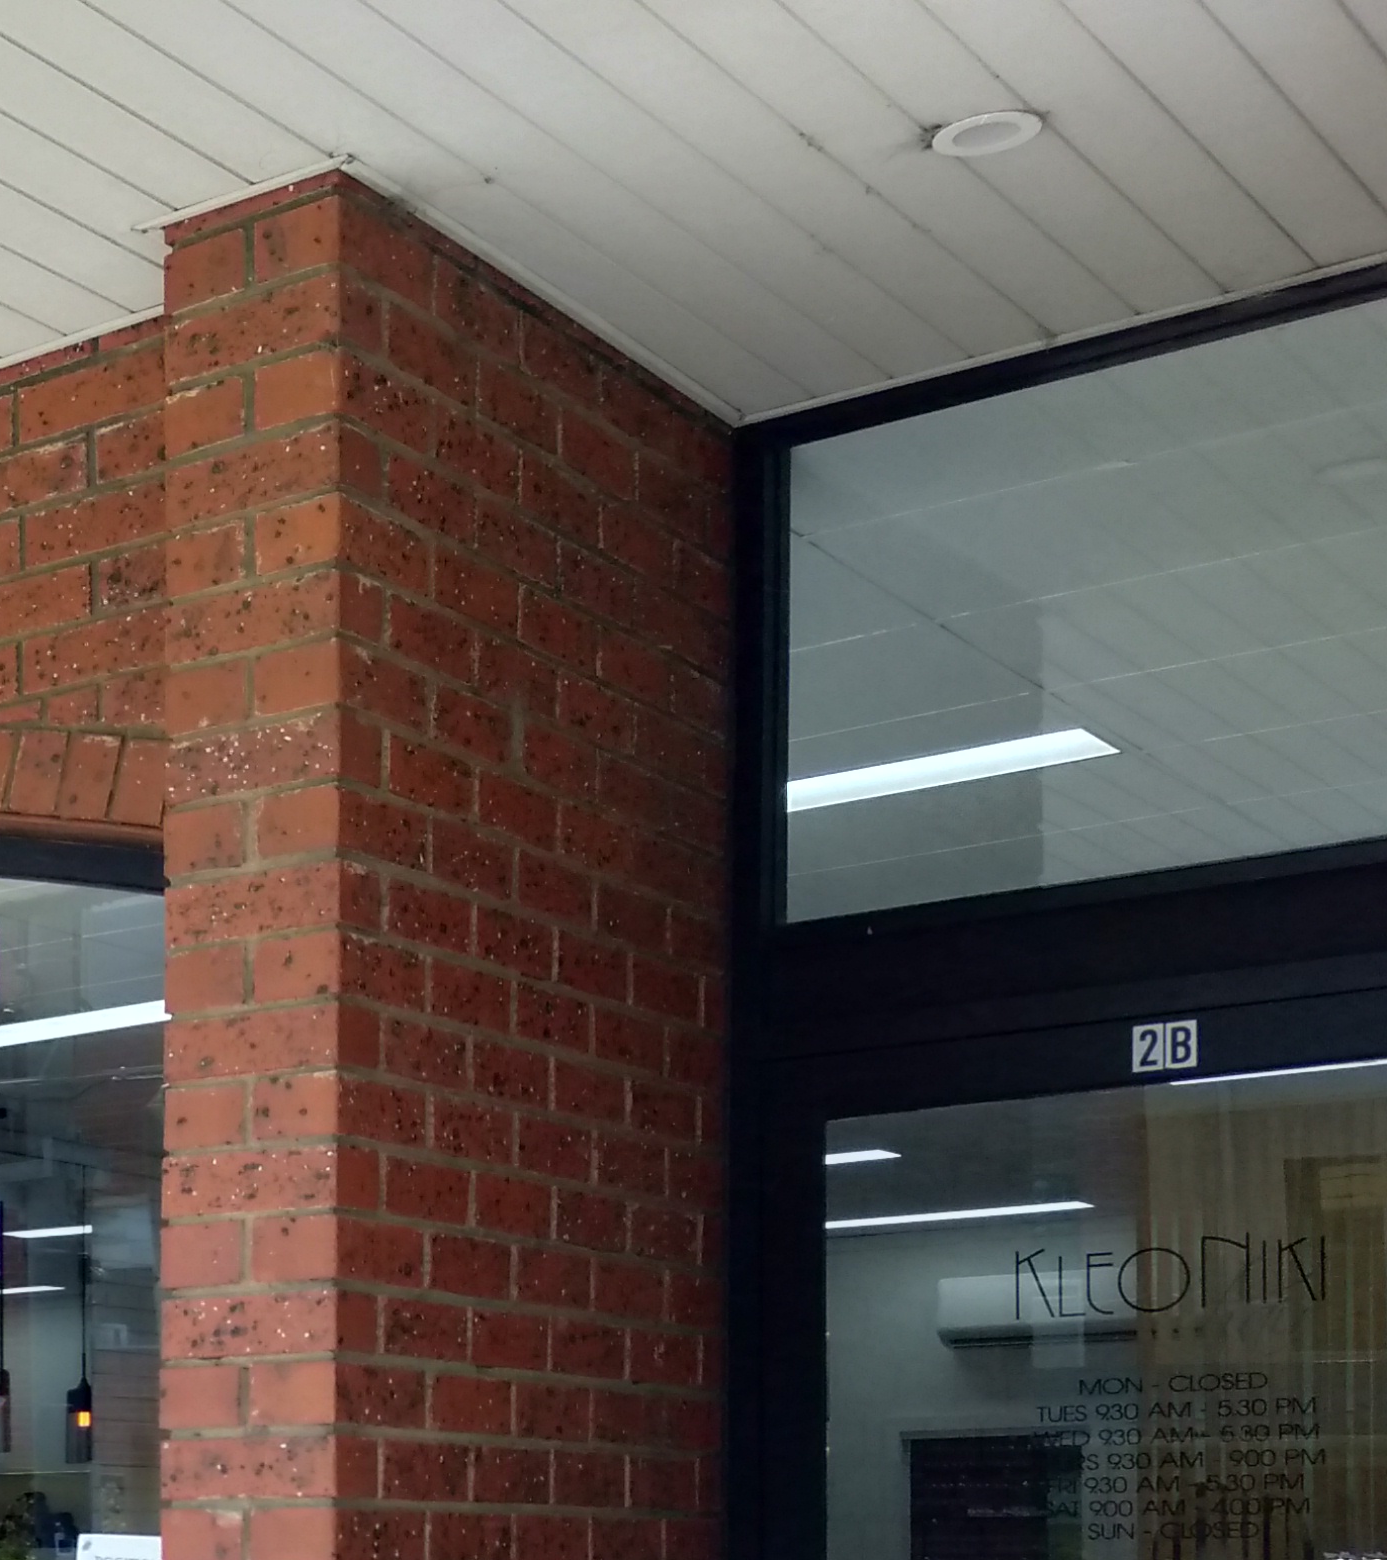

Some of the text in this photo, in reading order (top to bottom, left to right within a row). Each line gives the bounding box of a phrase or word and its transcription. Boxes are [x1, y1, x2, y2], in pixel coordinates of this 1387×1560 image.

[1137, 1026, 1193, 1067] 2B
[1013, 1232, 1327, 1320] KLEONIKI
[1078, 1378, 1143, 1396] MON
[1169, 1372, 1268, 1393] CLOSED
[1036, 1405, 1088, 1423] TUES
[1147, 1401, 1192, 1418] AM
[1275, 1396, 1318, 1414] PM
[1149, 1426, 1195, 1442] AM
[1278, 1422, 1321, 1440] PM
[1158, 1450, 1204, 1468] AM
[1284, 1448, 1327, 1465] PM
[1135, 1475, 1181, 1493] AM
[1263, 1473, 1305, 1491] PM
[1142, 1499, 1186, 1516] AM
[1086, 1523, 1135, 1541] SUN
[1160, 1520, 1260, 1540] CLOSED
